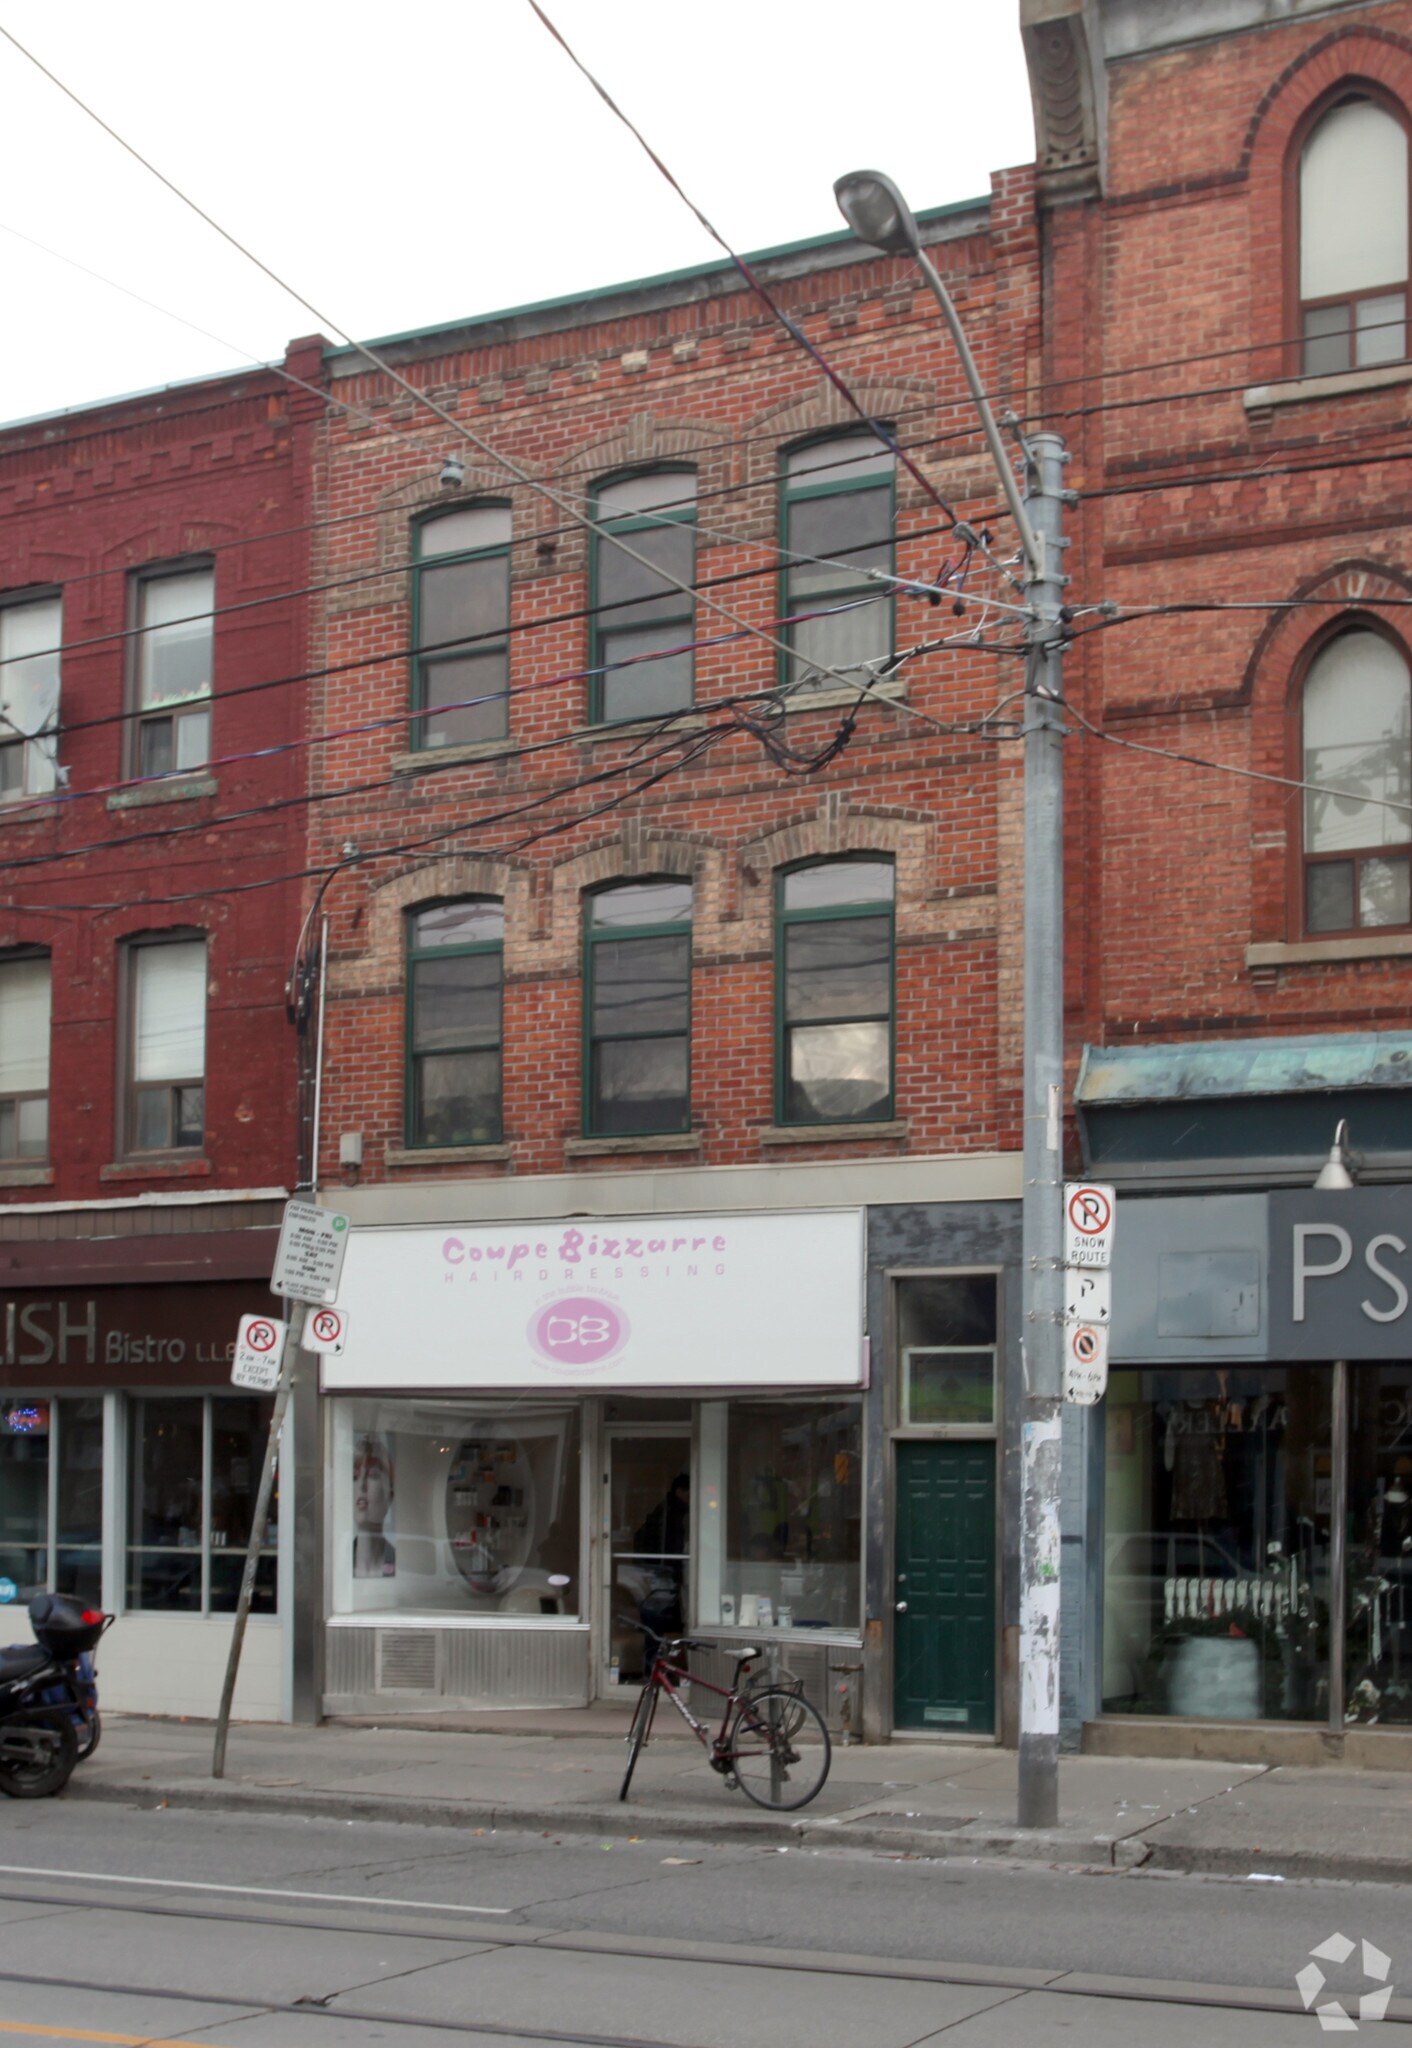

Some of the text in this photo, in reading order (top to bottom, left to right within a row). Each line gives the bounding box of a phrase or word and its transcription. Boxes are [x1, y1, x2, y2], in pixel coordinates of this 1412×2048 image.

[442, 1228, 726, 1270] Coupe Bizzarre
[1074, 1237, 1105, 1248] SNOW
[1071, 1250, 1106, 1263] ROUTE
[444, 1263, 726, 1283] HAIRDRESSING
[0, 1301, 96, 1365] ISH
[105, 1330, 186, 1364] Bistro
[243, 1365, 269, 1375] EXCEPT
[248, 1375, 273, 1387] PERMIT
